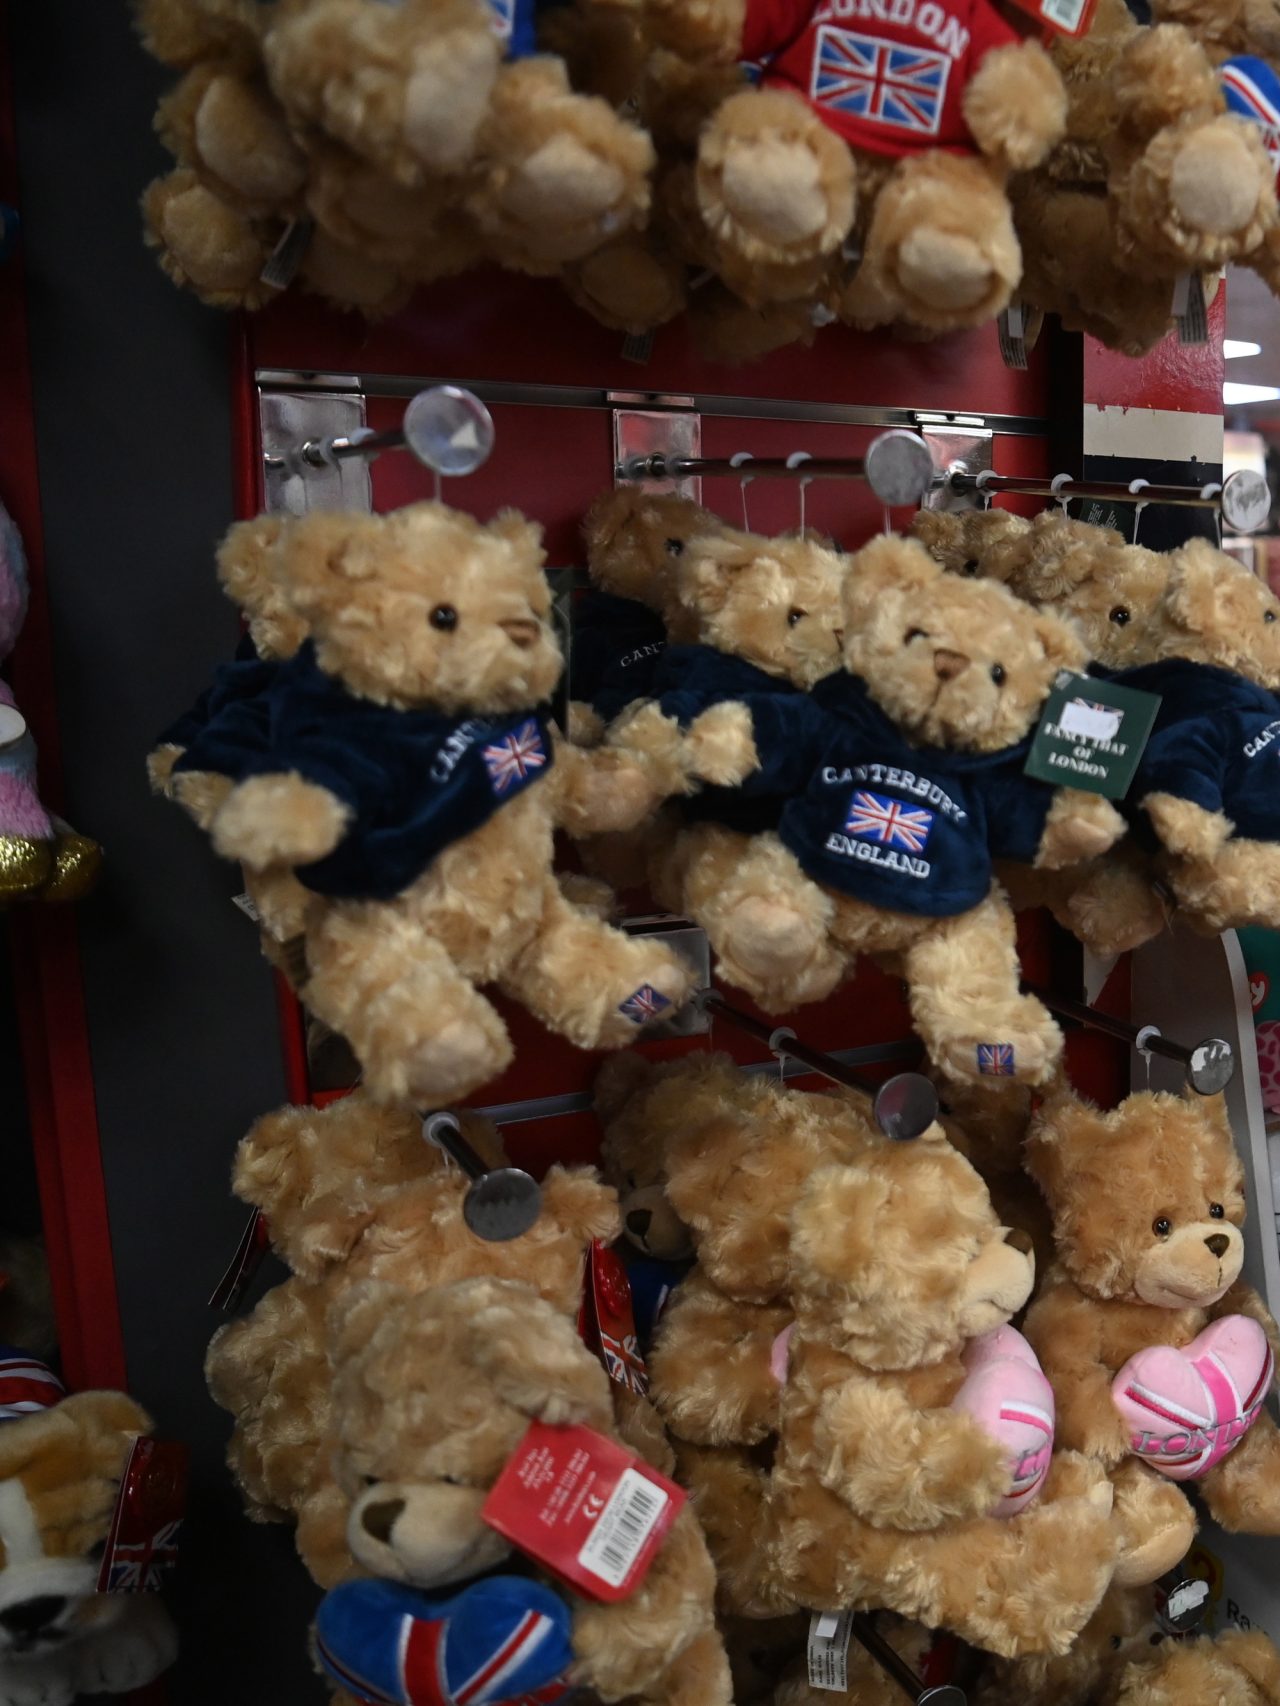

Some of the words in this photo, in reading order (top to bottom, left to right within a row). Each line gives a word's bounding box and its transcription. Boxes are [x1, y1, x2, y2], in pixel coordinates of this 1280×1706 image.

[812, 0, 970, 60] LONDON
[620, 641, 665, 667] CAN
[1048, 752, 1109, 778] LONDON
[1073, 745, 1094, 761] OF
[822, 763, 968, 823] CANTERBURY
[824, 832, 931, 879] ENGLAND
